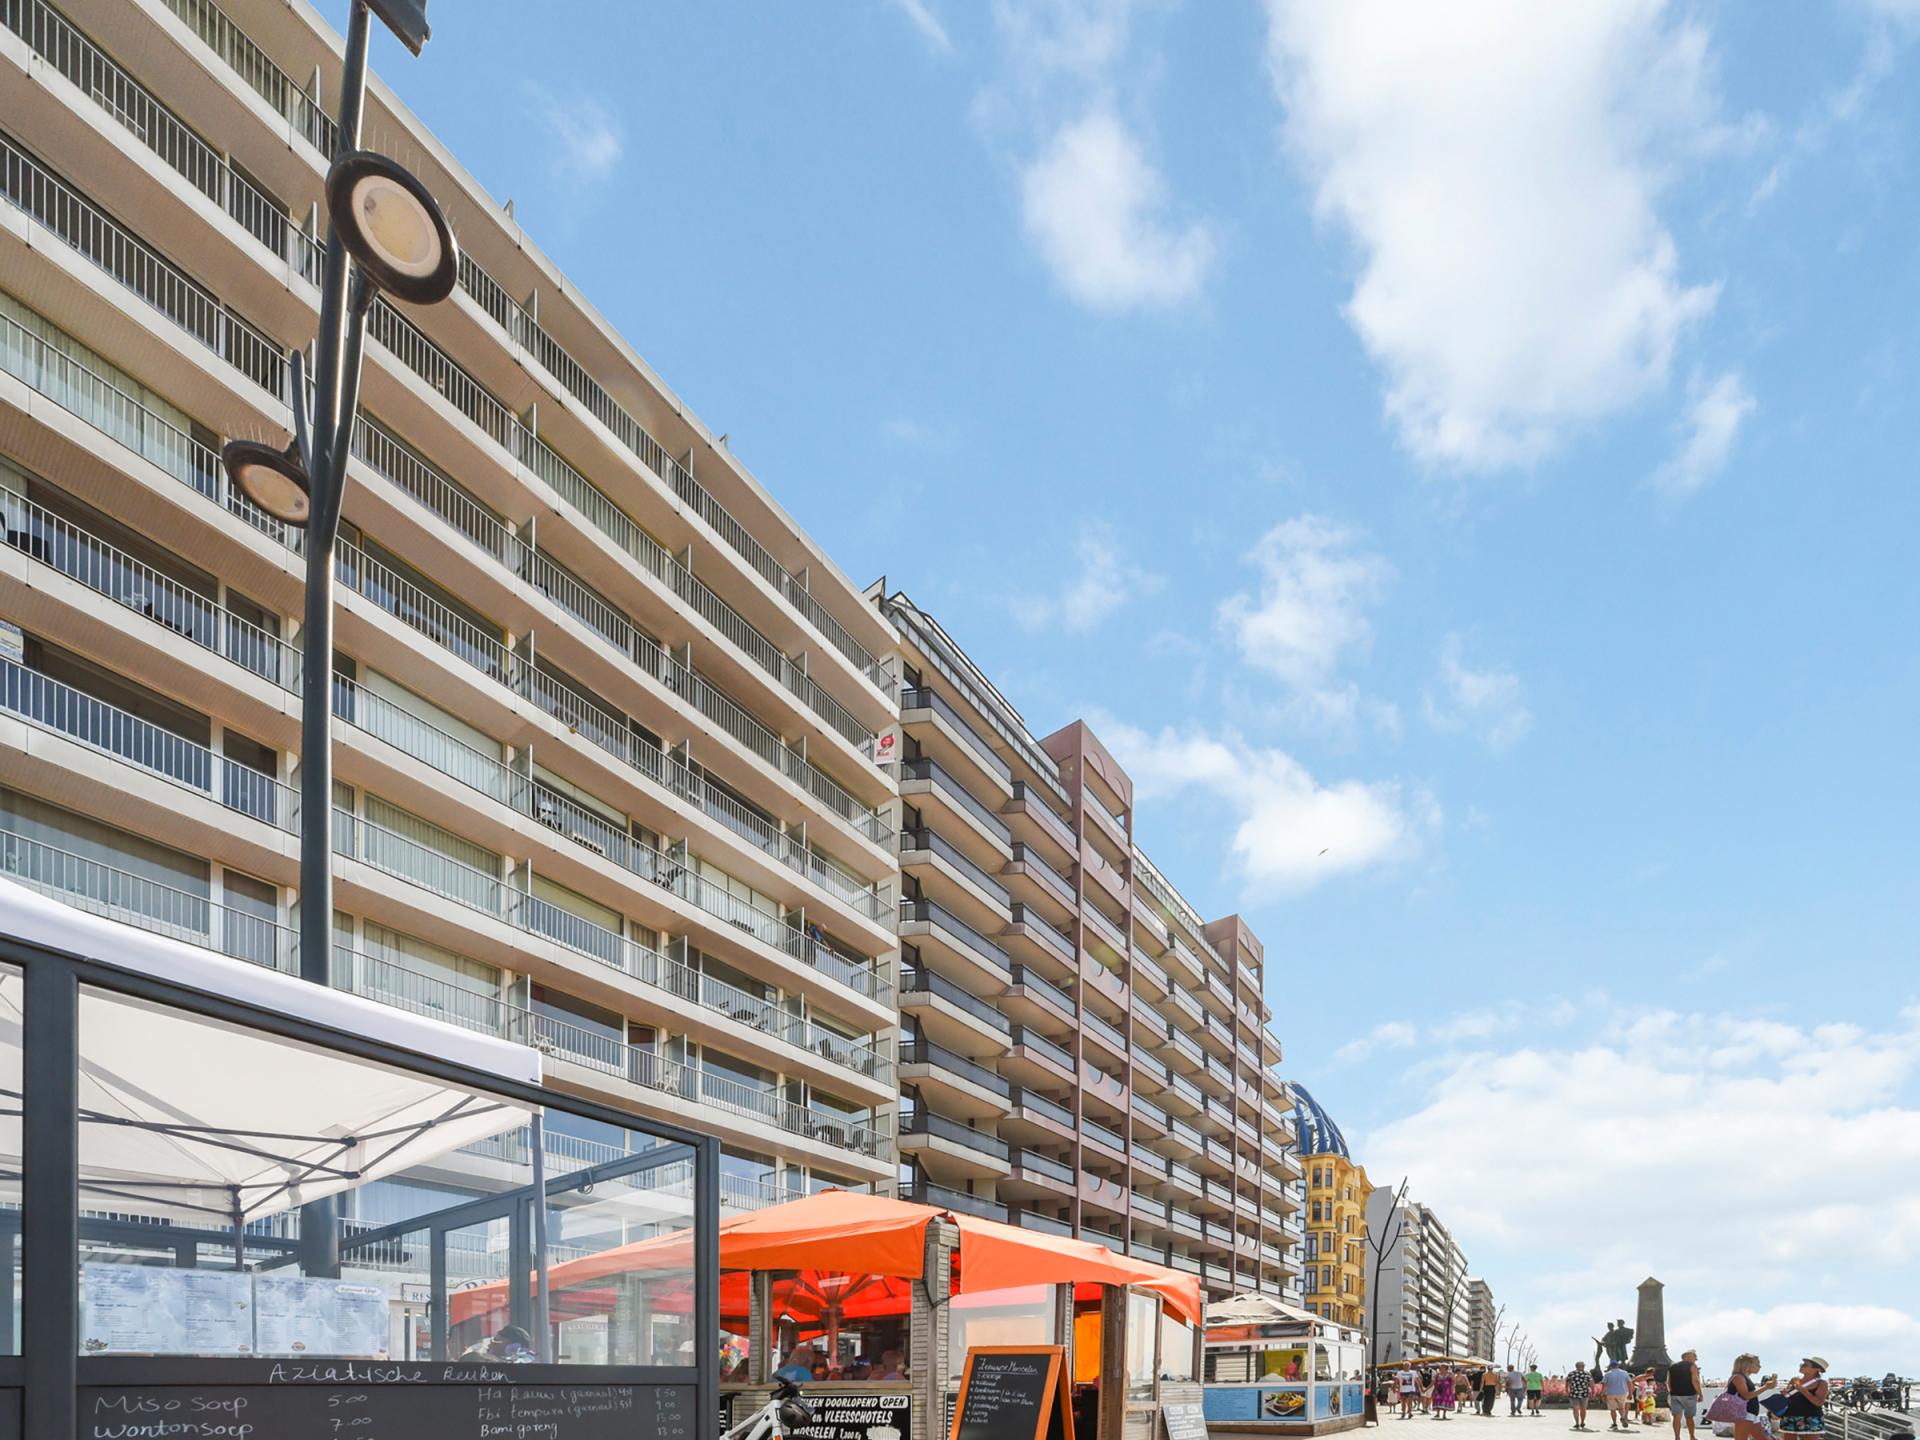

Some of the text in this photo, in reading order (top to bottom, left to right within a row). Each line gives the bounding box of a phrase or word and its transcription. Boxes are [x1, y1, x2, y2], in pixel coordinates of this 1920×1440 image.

[269, 1363, 427, 1384] Aziatische
[95, 1396, 181, 1415] Miso
[825, 1397, 879, 1408] DOORLOPEND
[882, 1398, 905, 1407] OPEN
[812, 1410, 893, 1424] en VLEESSCHOTELS
[480, 1424, 514, 1437] Bami
